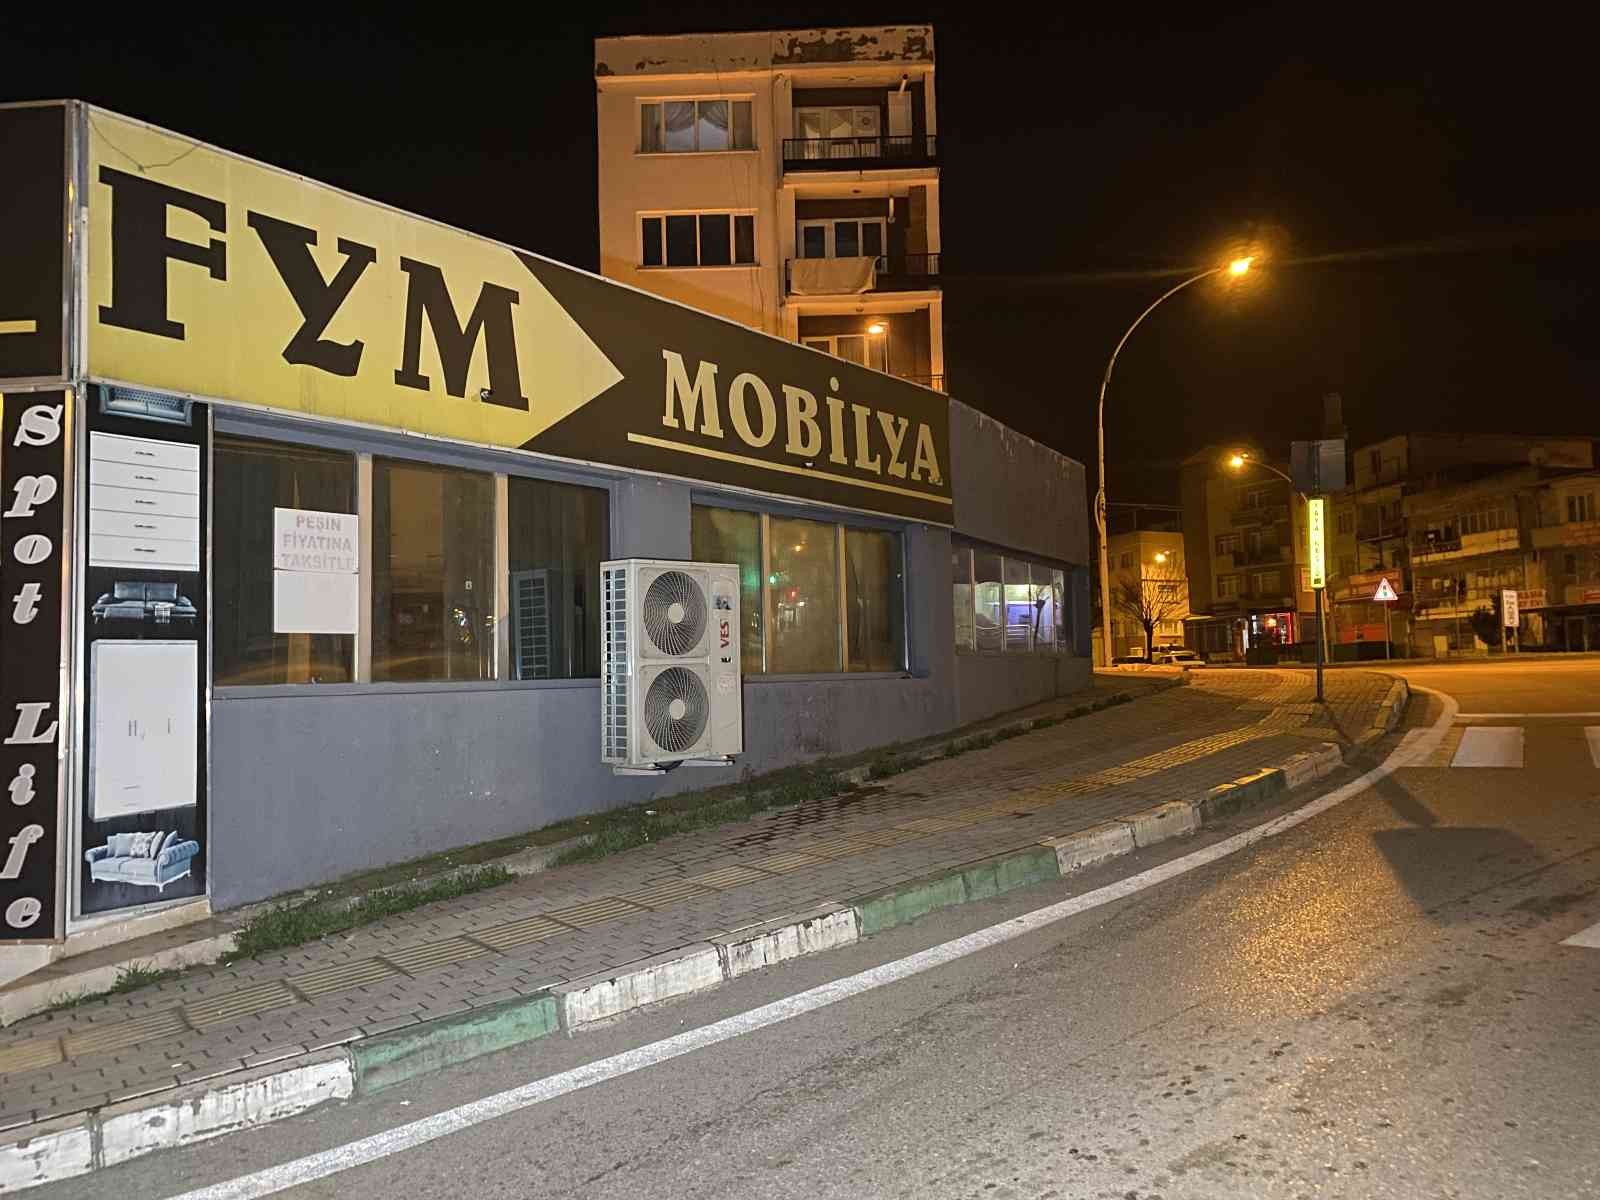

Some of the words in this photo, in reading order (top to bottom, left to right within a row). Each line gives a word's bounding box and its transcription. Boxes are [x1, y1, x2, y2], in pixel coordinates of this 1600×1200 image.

[99, 165, 529, 412] FYM
[661, 348, 944, 487] MOBİLYA
[3, 405, 63, 625] Spot
[0, 702, 59, 929] Life
